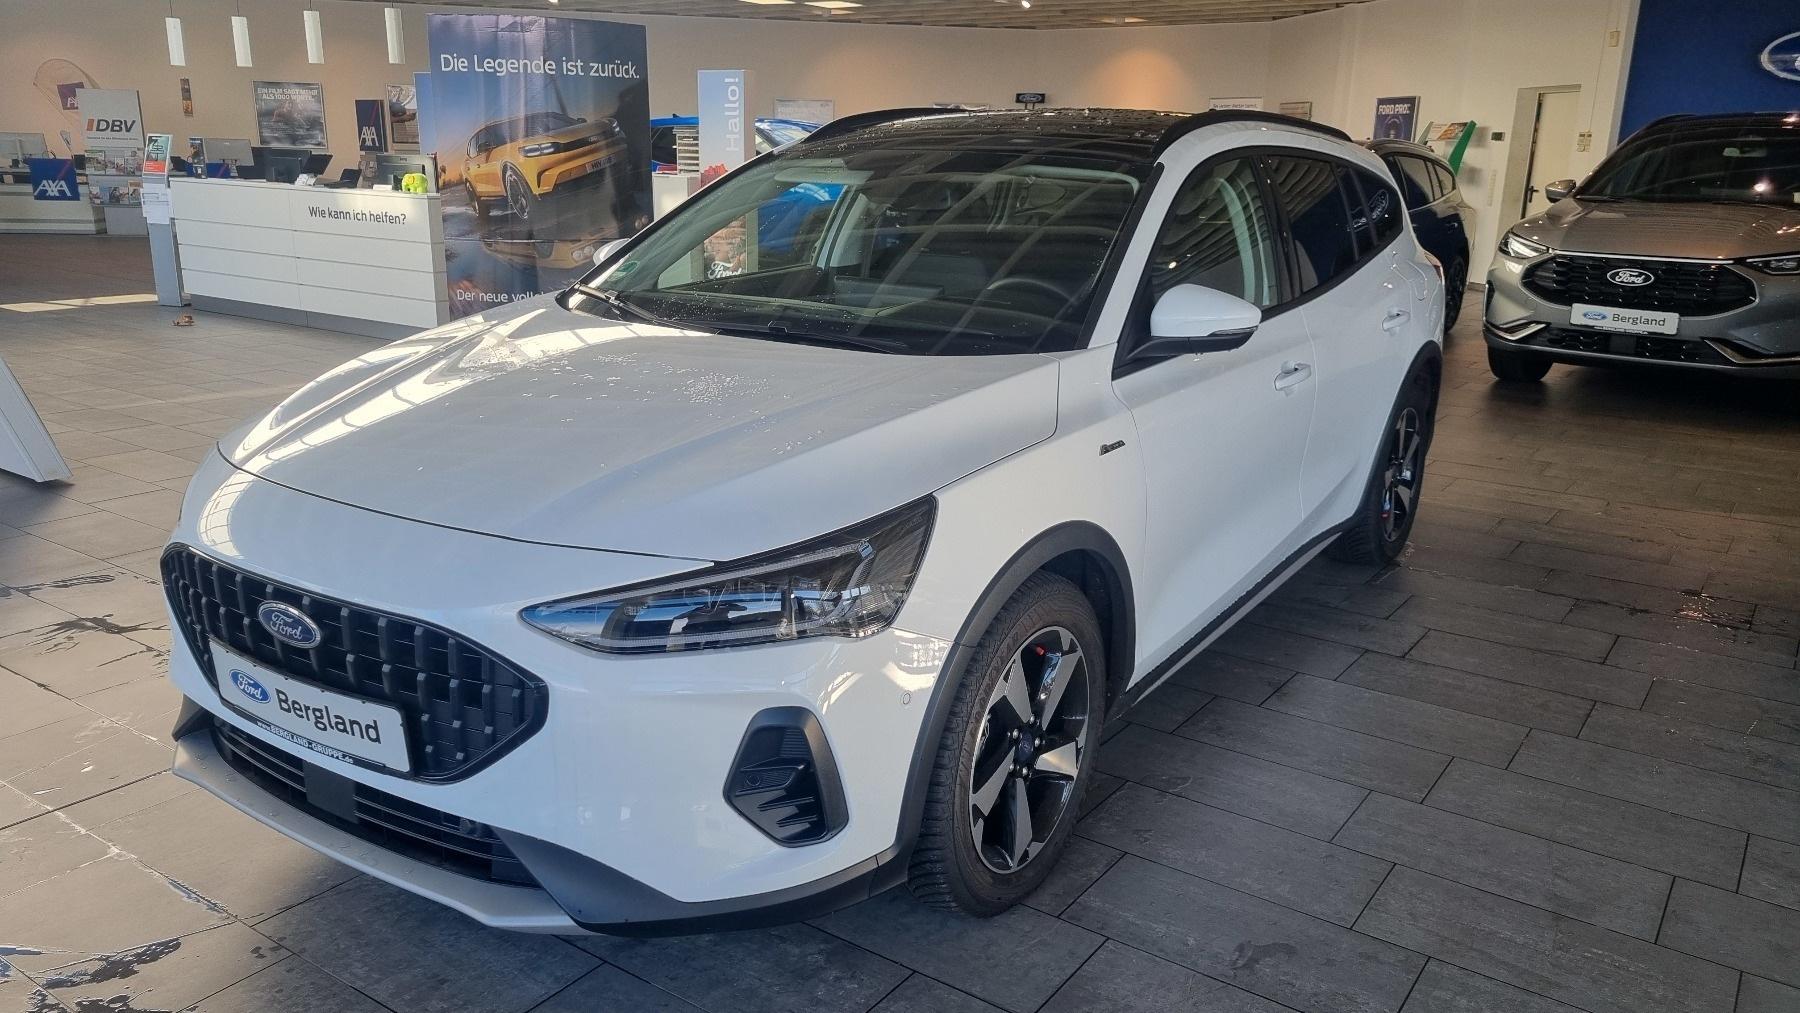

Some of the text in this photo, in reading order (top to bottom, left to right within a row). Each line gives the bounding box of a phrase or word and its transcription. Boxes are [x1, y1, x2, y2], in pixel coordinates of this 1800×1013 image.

[440, 53, 640, 79] Die Legende ist zurück.
[724, 77, 739, 152] Hallo!
[95, 119, 137, 133] DBV
[359, 126, 379, 147] AXA
[33, 178, 72, 197] AXA
[308, 205, 407, 225] Wie kann ich helfen?
[1615, 270, 1645, 284] Ford
[457, 289, 475, 301] Der
[479, 293, 508, 303] neue
[1612, 313, 1666, 326] Bergland
[270, 611, 303, 640] Ford
[275, 687, 382, 745] Bergland
